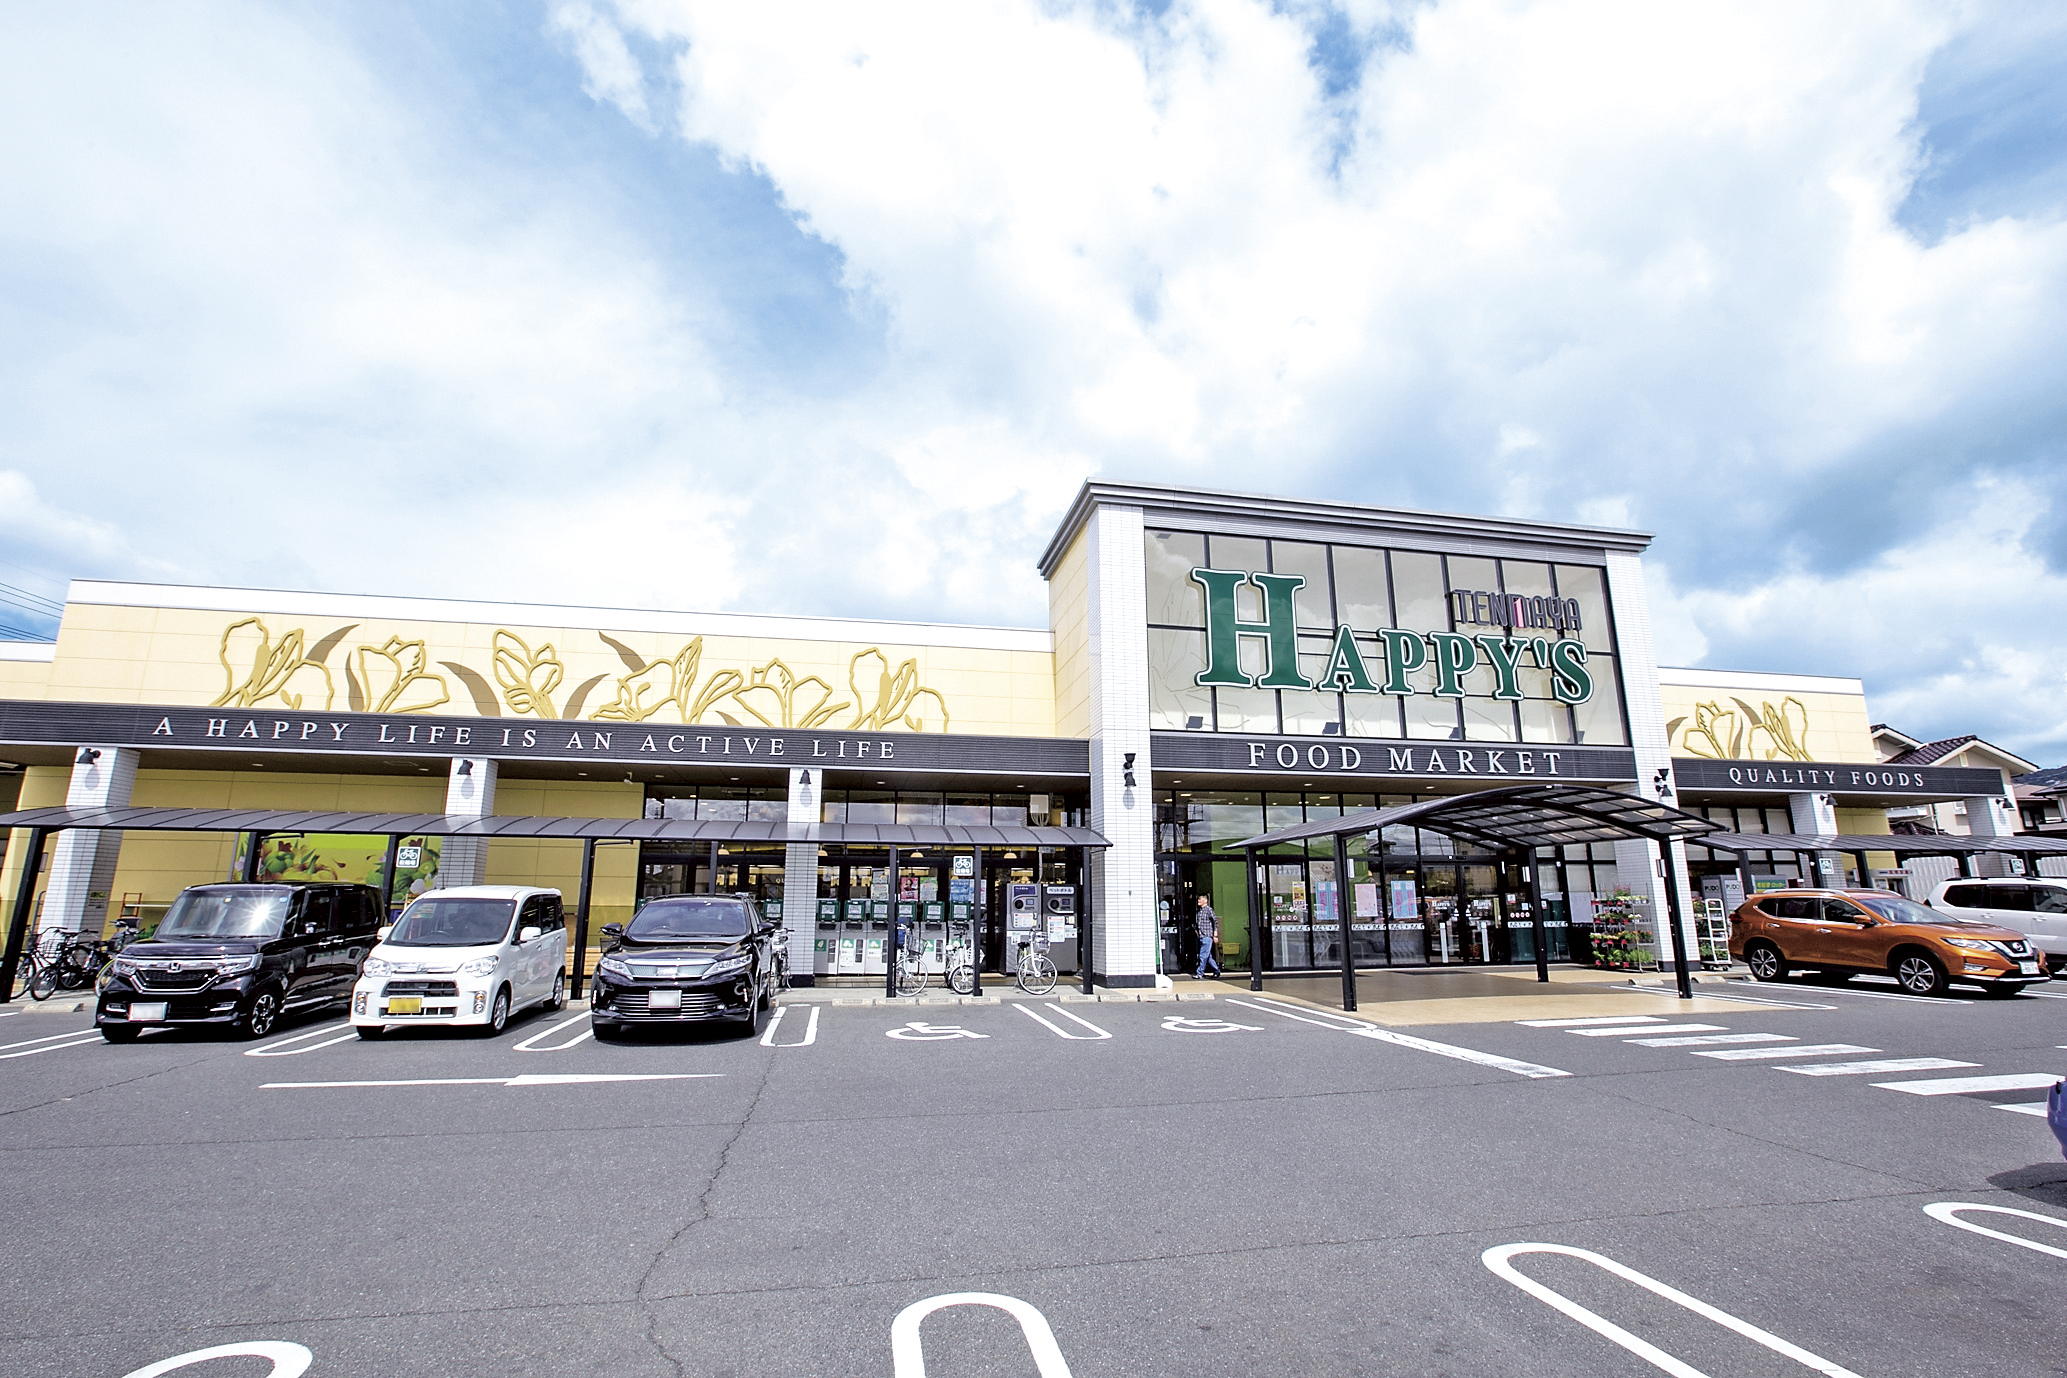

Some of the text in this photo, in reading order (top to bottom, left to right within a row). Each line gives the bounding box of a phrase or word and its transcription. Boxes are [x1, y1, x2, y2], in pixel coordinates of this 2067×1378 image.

[1452, 589, 1582, 631] TENMAYA
[1190, 567, 1594, 705] HAPPY'S
[152, 716, 894, 759] A HAPPY LIFE IS AN ACTIVE LIFE
[1247, 742, 1560, 775] FOOD MARKET
[1728, 767, 1924, 787] QUALITY FOODS
